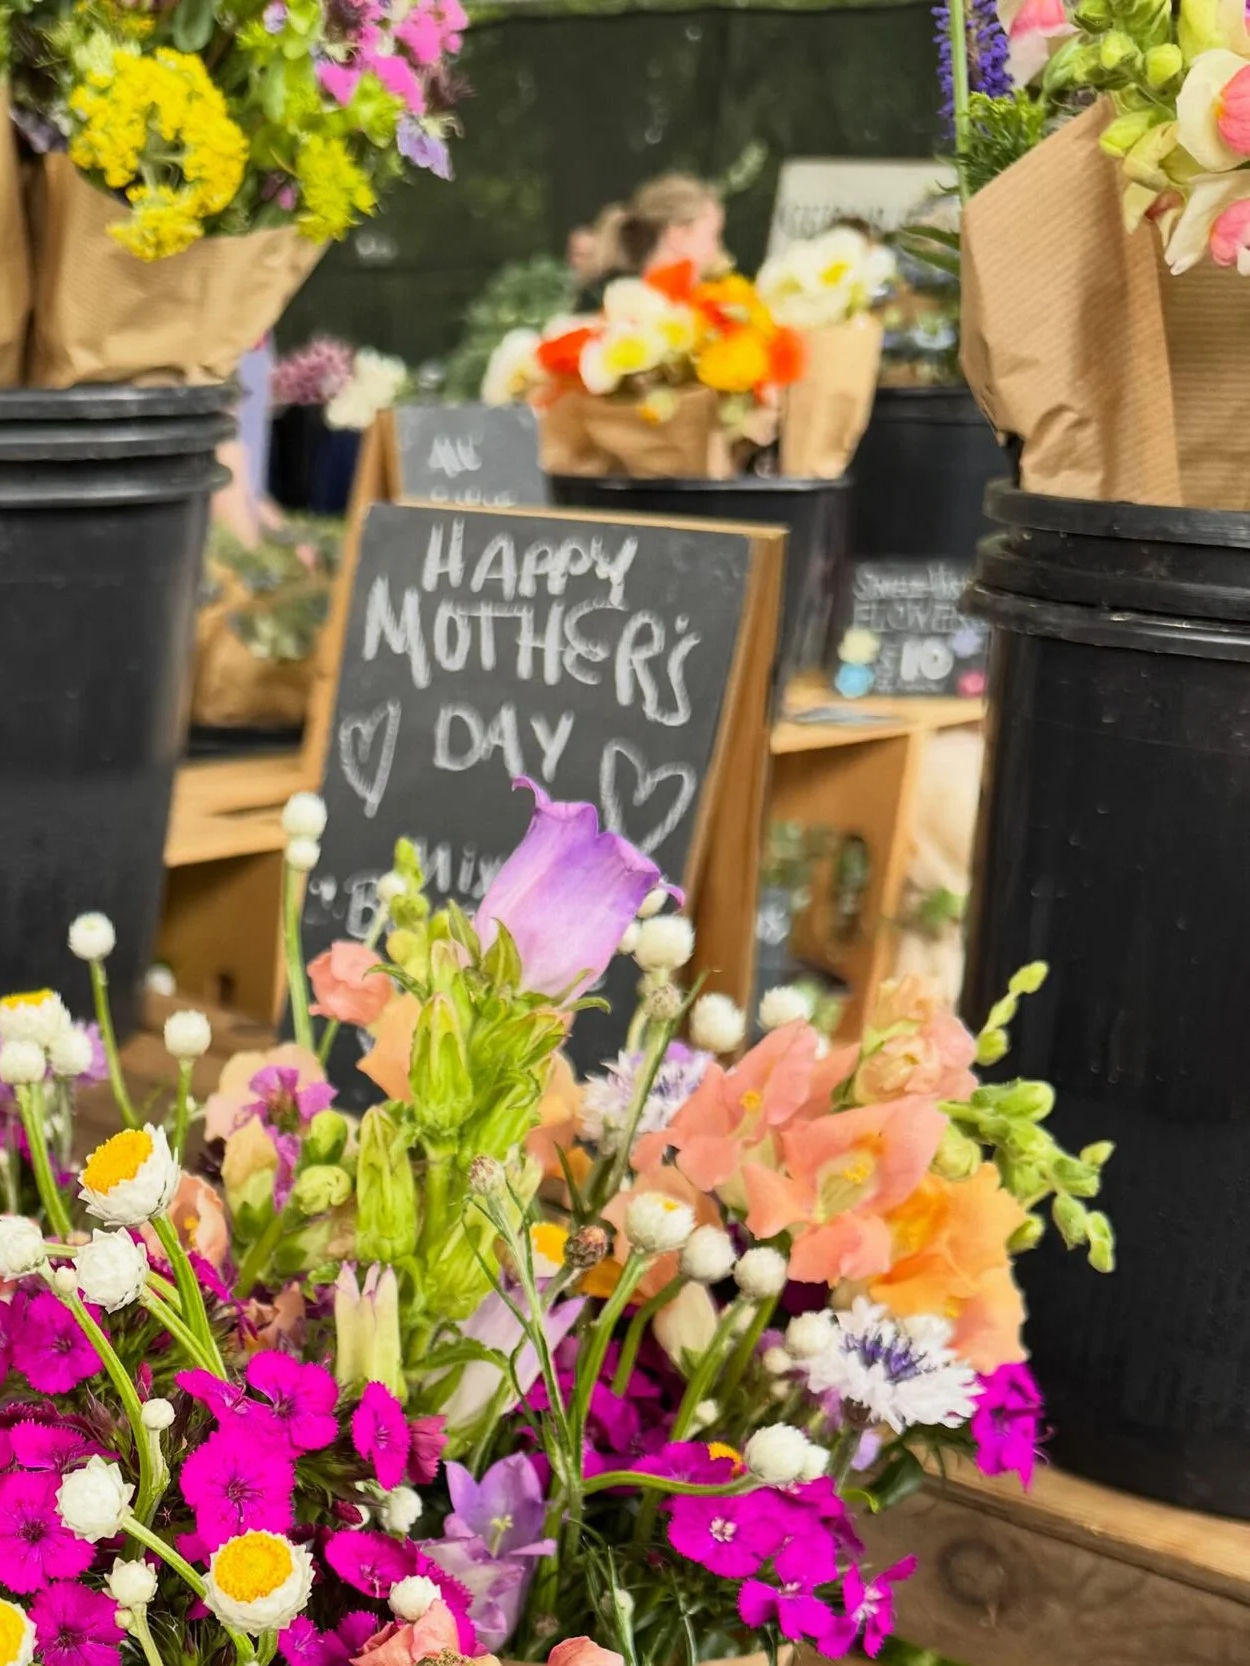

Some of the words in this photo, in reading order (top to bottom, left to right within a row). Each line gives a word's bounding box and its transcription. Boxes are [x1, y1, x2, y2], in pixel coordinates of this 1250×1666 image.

[423, 518, 638, 603] HAPPY
[364, 576, 701, 726] MOTHER'S
[433, 703, 573, 778] DAY
